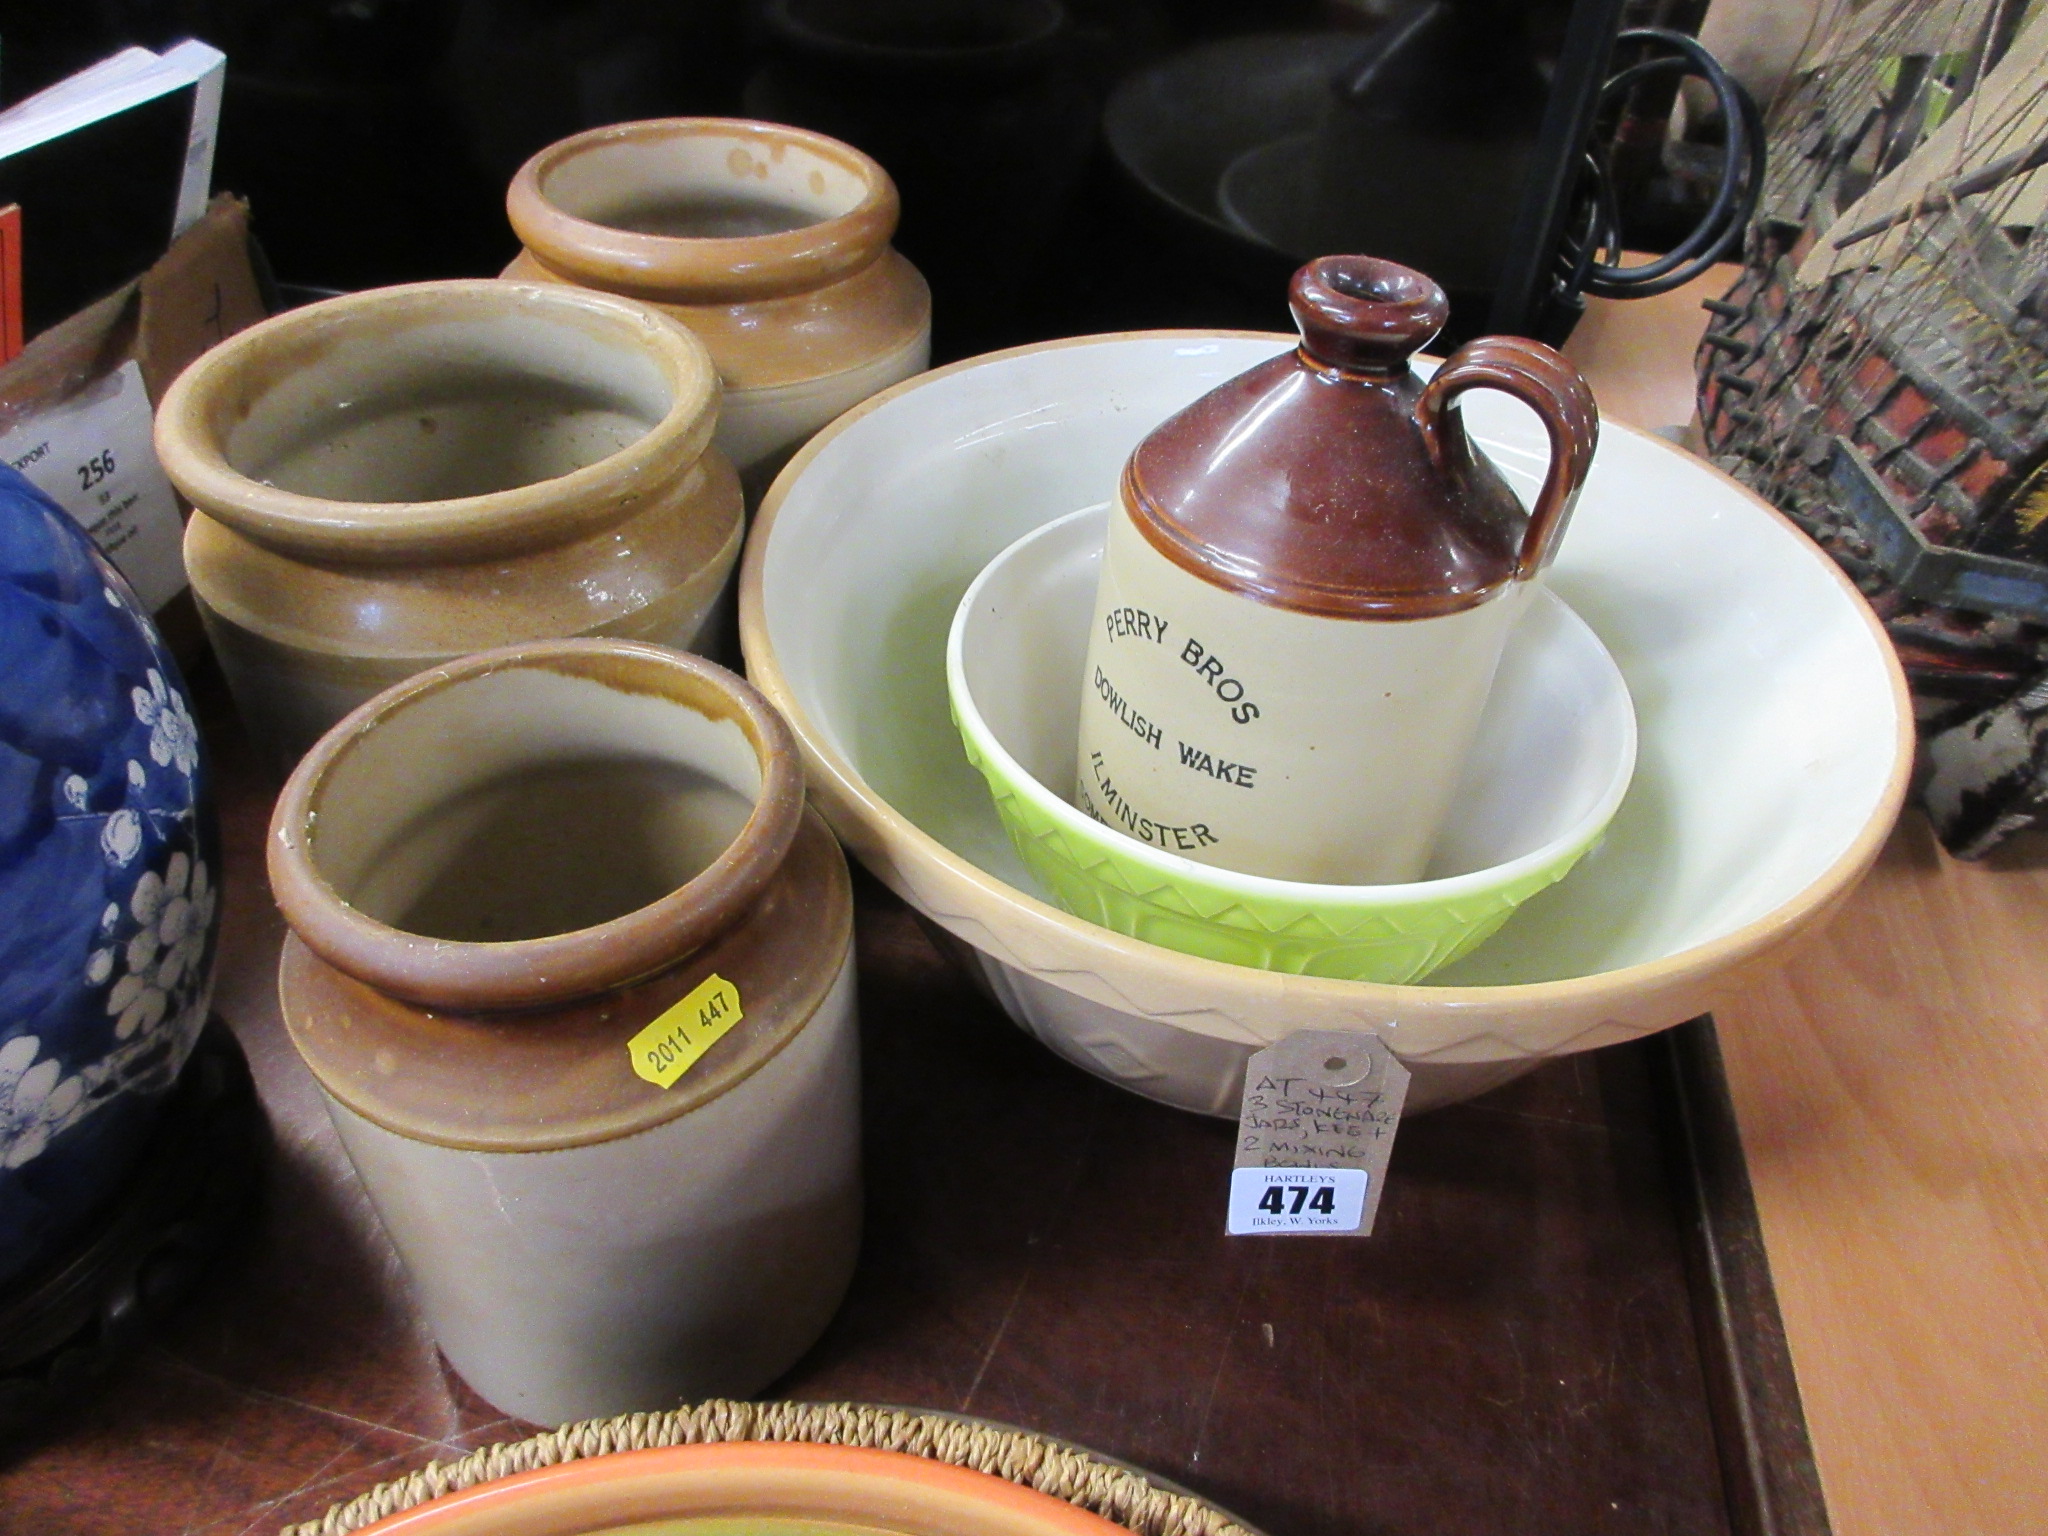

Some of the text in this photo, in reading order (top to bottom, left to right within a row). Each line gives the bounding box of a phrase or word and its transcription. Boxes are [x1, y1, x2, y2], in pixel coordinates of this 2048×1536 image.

[77, 448, 115, 491] 256
[1106, 607, 1260, 724] PERRY BROS
[1094, 664, 1257, 788] DOWLISH WAKE
[1091, 751, 1219, 850] ILMINSTER
[647, 991, 730, 1073] 2011 447
[1248, 1094, 1268, 1112] 3
[1256, 1075, 1384, 1109] AT 447
[1244, 1135, 1366, 1158] 2 MIXING
[1264, 1175, 1336, 1184] HARTLEYS
[1258, 1185, 1336, 1215] 474
[1252, 1217, 1338, 1227] Ilkley, W. Yorks
